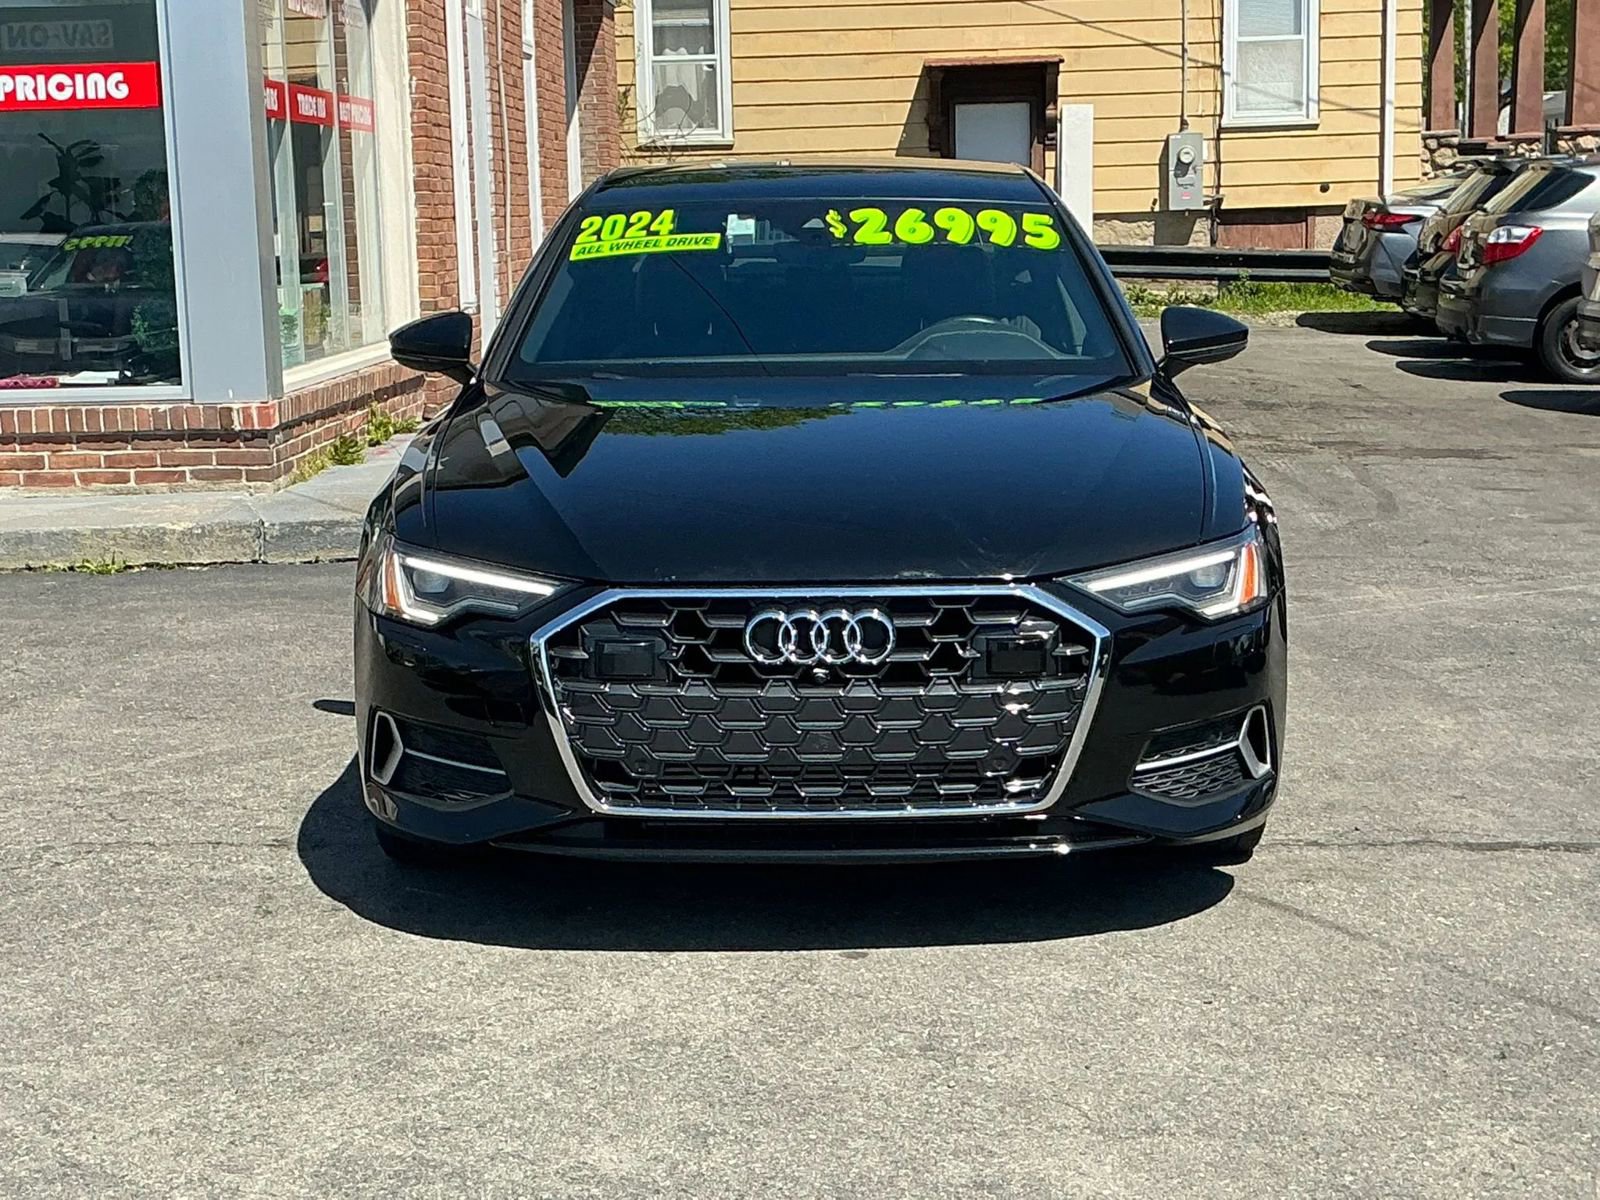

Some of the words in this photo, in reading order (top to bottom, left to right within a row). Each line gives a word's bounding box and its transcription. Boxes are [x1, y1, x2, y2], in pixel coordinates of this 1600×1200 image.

[0, 71, 130, 102] PRICING
[575, 209, 675, 244] 2024
[825, 207, 1061, 250] $26995
[576, 244, 604, 256] ALL
[609, 239, 661, 252] WHEEL
[665, 235, 714, 247] DRIVE
